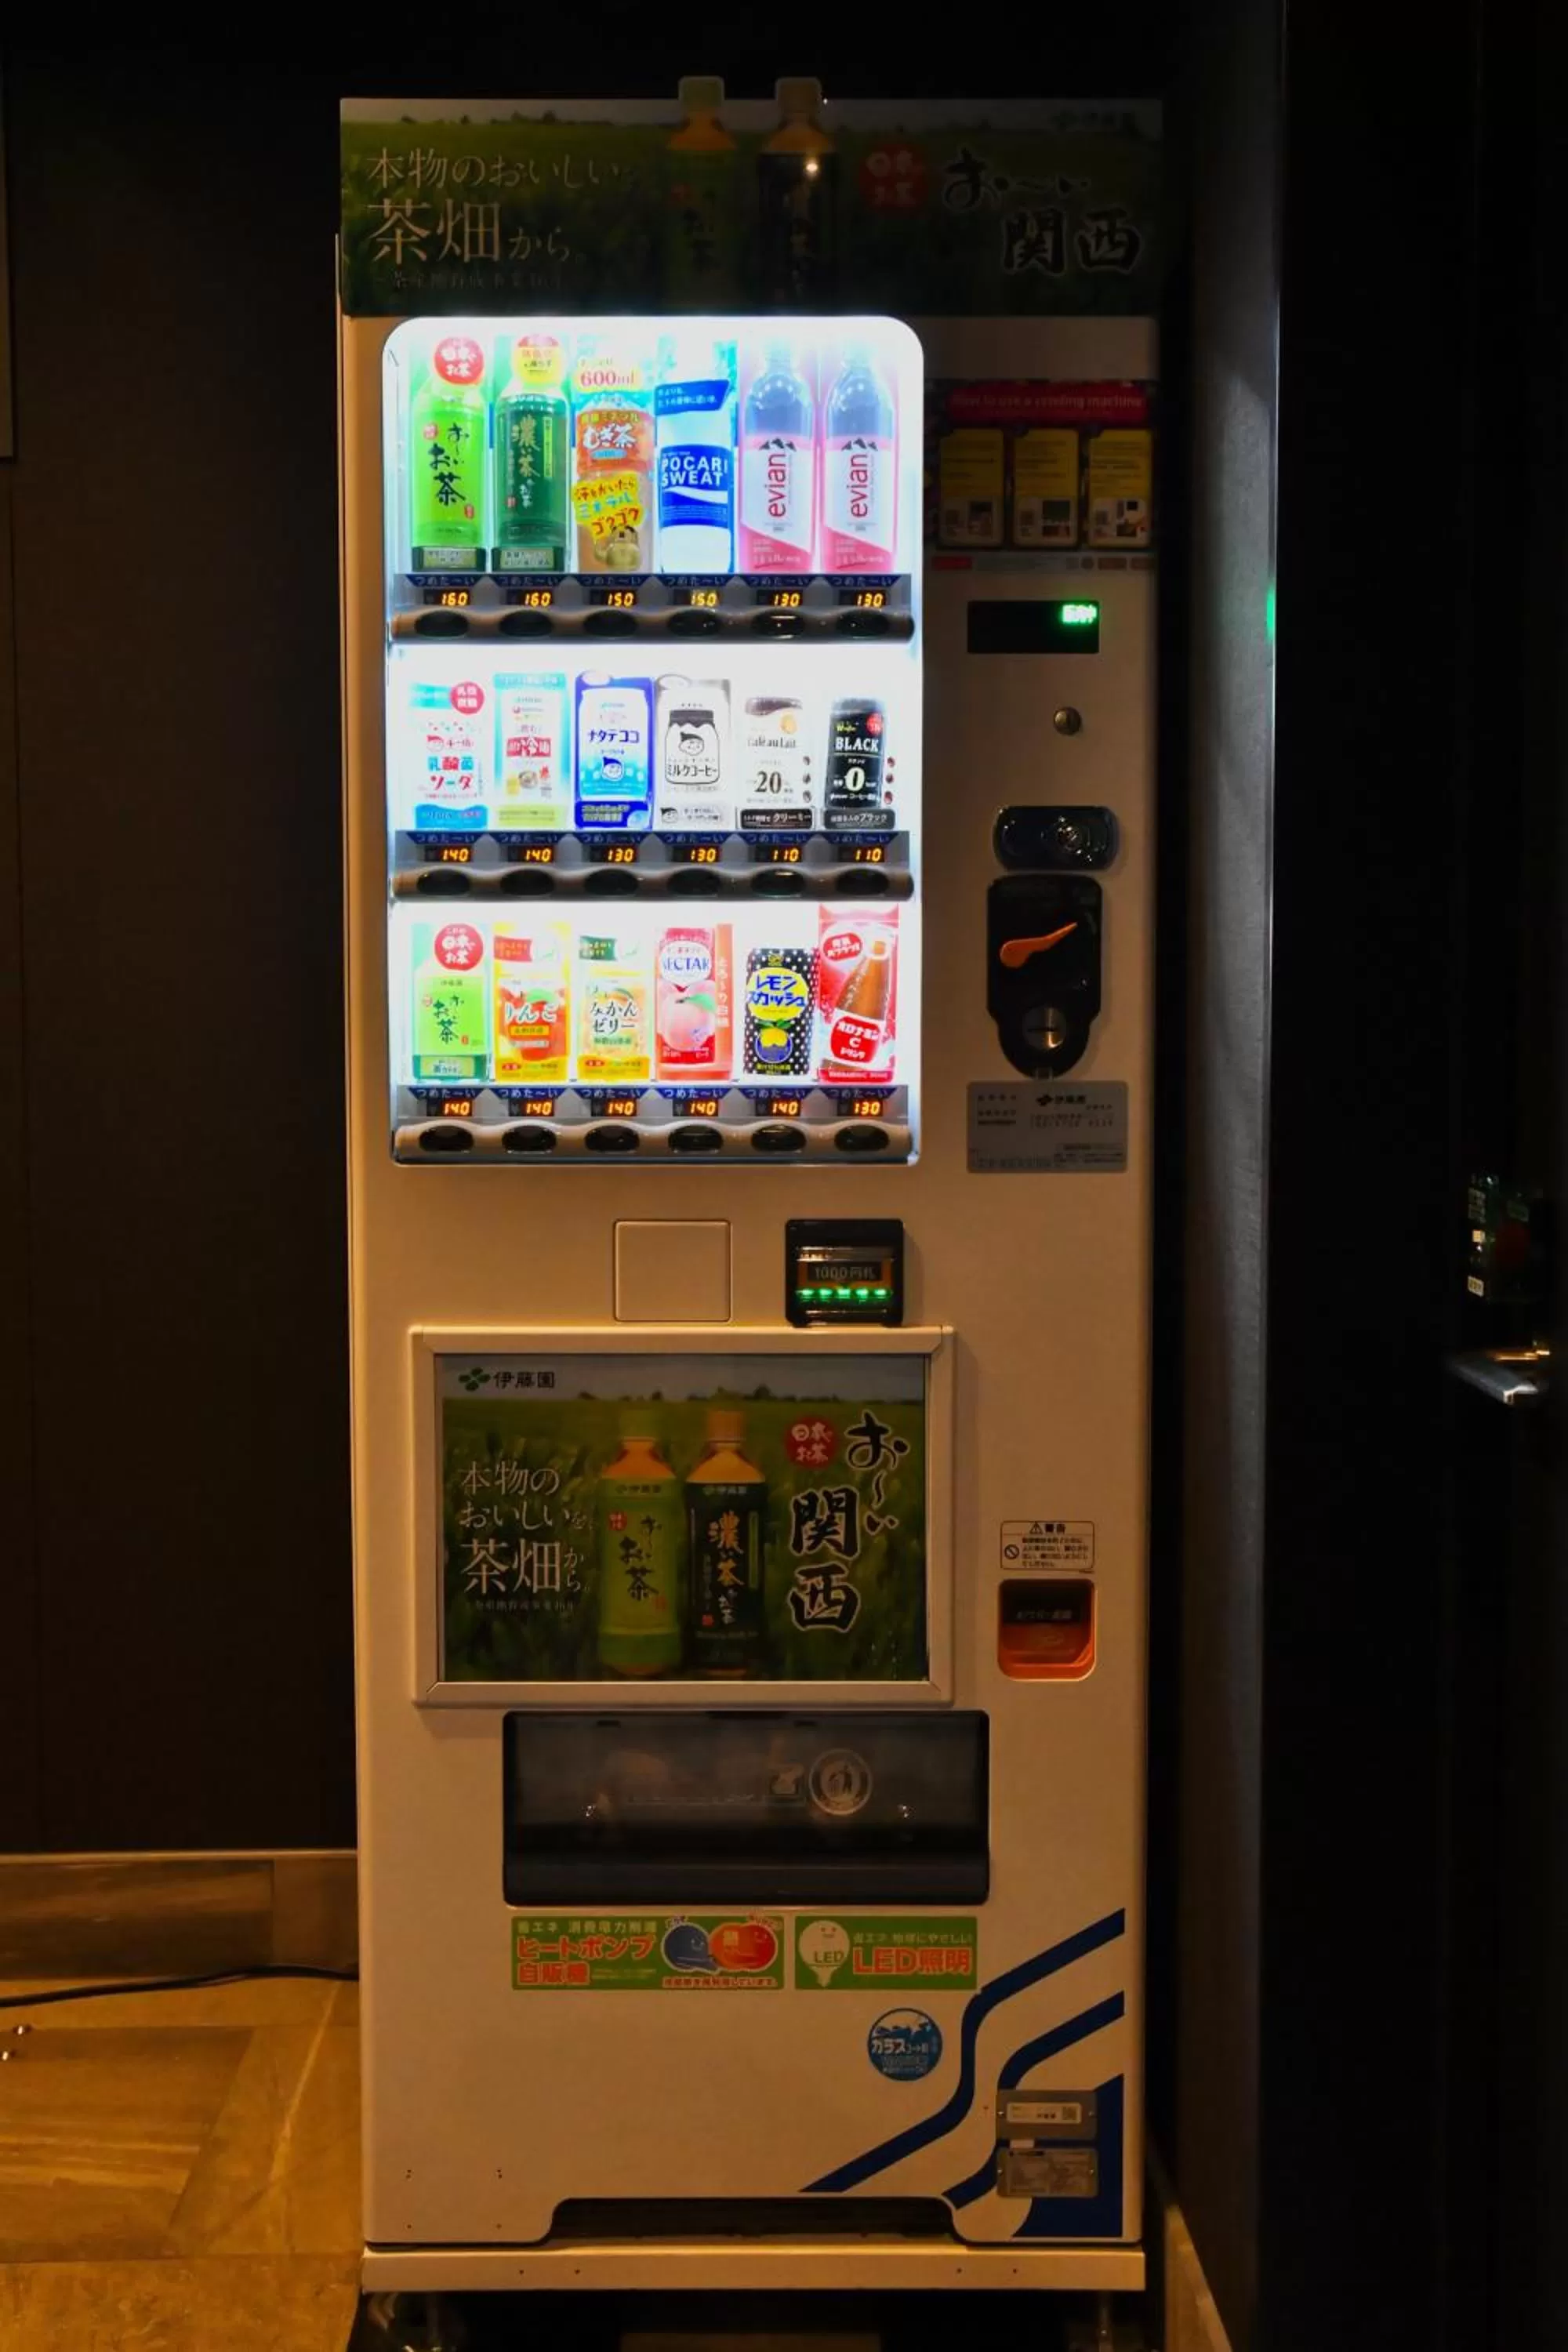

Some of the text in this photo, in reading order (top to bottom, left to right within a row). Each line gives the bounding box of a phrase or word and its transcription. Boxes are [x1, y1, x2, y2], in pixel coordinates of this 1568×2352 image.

[1003, 209, 1139, 276] 関西
[583, 423, 637, 449] むぎ茶
[661, 456, 728, 473] POCARI
[427, 443, 466, 506] お茶
[661, 470, 723, 486] SWEAT
[764, 453, 786, 518] evian
[846, 453, 869, 518] evian
[441, 592, 468, 607] 160
[525, 592, 551, 608] 160
[608, 593, 633, 607] 150
[691, 592, 717, 607] 150
[774, 593, 800, 608] 130
[858, 593, 883, 608] 130
[835, 737, 879, 752] BLACK
[667, 764, 717, 777] ミルクコーヒー
[430, 774, 474, 791] ソーダ
[755, 771, 782, 794] 20
[443, 848, 469, 862] 140
[526, 848, 551, 862] 140
[608, 848, 634, 862] 130
[691, 848, 717, 862] 130
[774, 848, 799, 862] 110
[856, 848, 882, 862] 110
[756, 975, 797, 990] レモン
[750, 991, 806, 1006] スカッシュ
[506, 1003, 557, 1022] りんご
[848, 1036, 862, 1048] C
[445, 1102, 470, 1116] 140
[526, 1101, 553, 1116] 140
[608, 1101, 634, 1116] 140
[691, 1102, 717, 1116] 140
[772, 1101, 798, 1115] 140
[855, 1101, 880, 1116] 130
[494, 1371, 555, 1388] 伊藤園
[460, 1460, 560, 1496] 本物の
[789, 1486, 861, 1632] 関西
[619, 1535, 659, 1601] お茶
[517, 1934, 660, 1961] ヒートポンプ
[814, 1951, 844, 1964] LED
[852, 1947, 973, 1976] LED照明
[517, 1959, 590, 1984] 自販機
